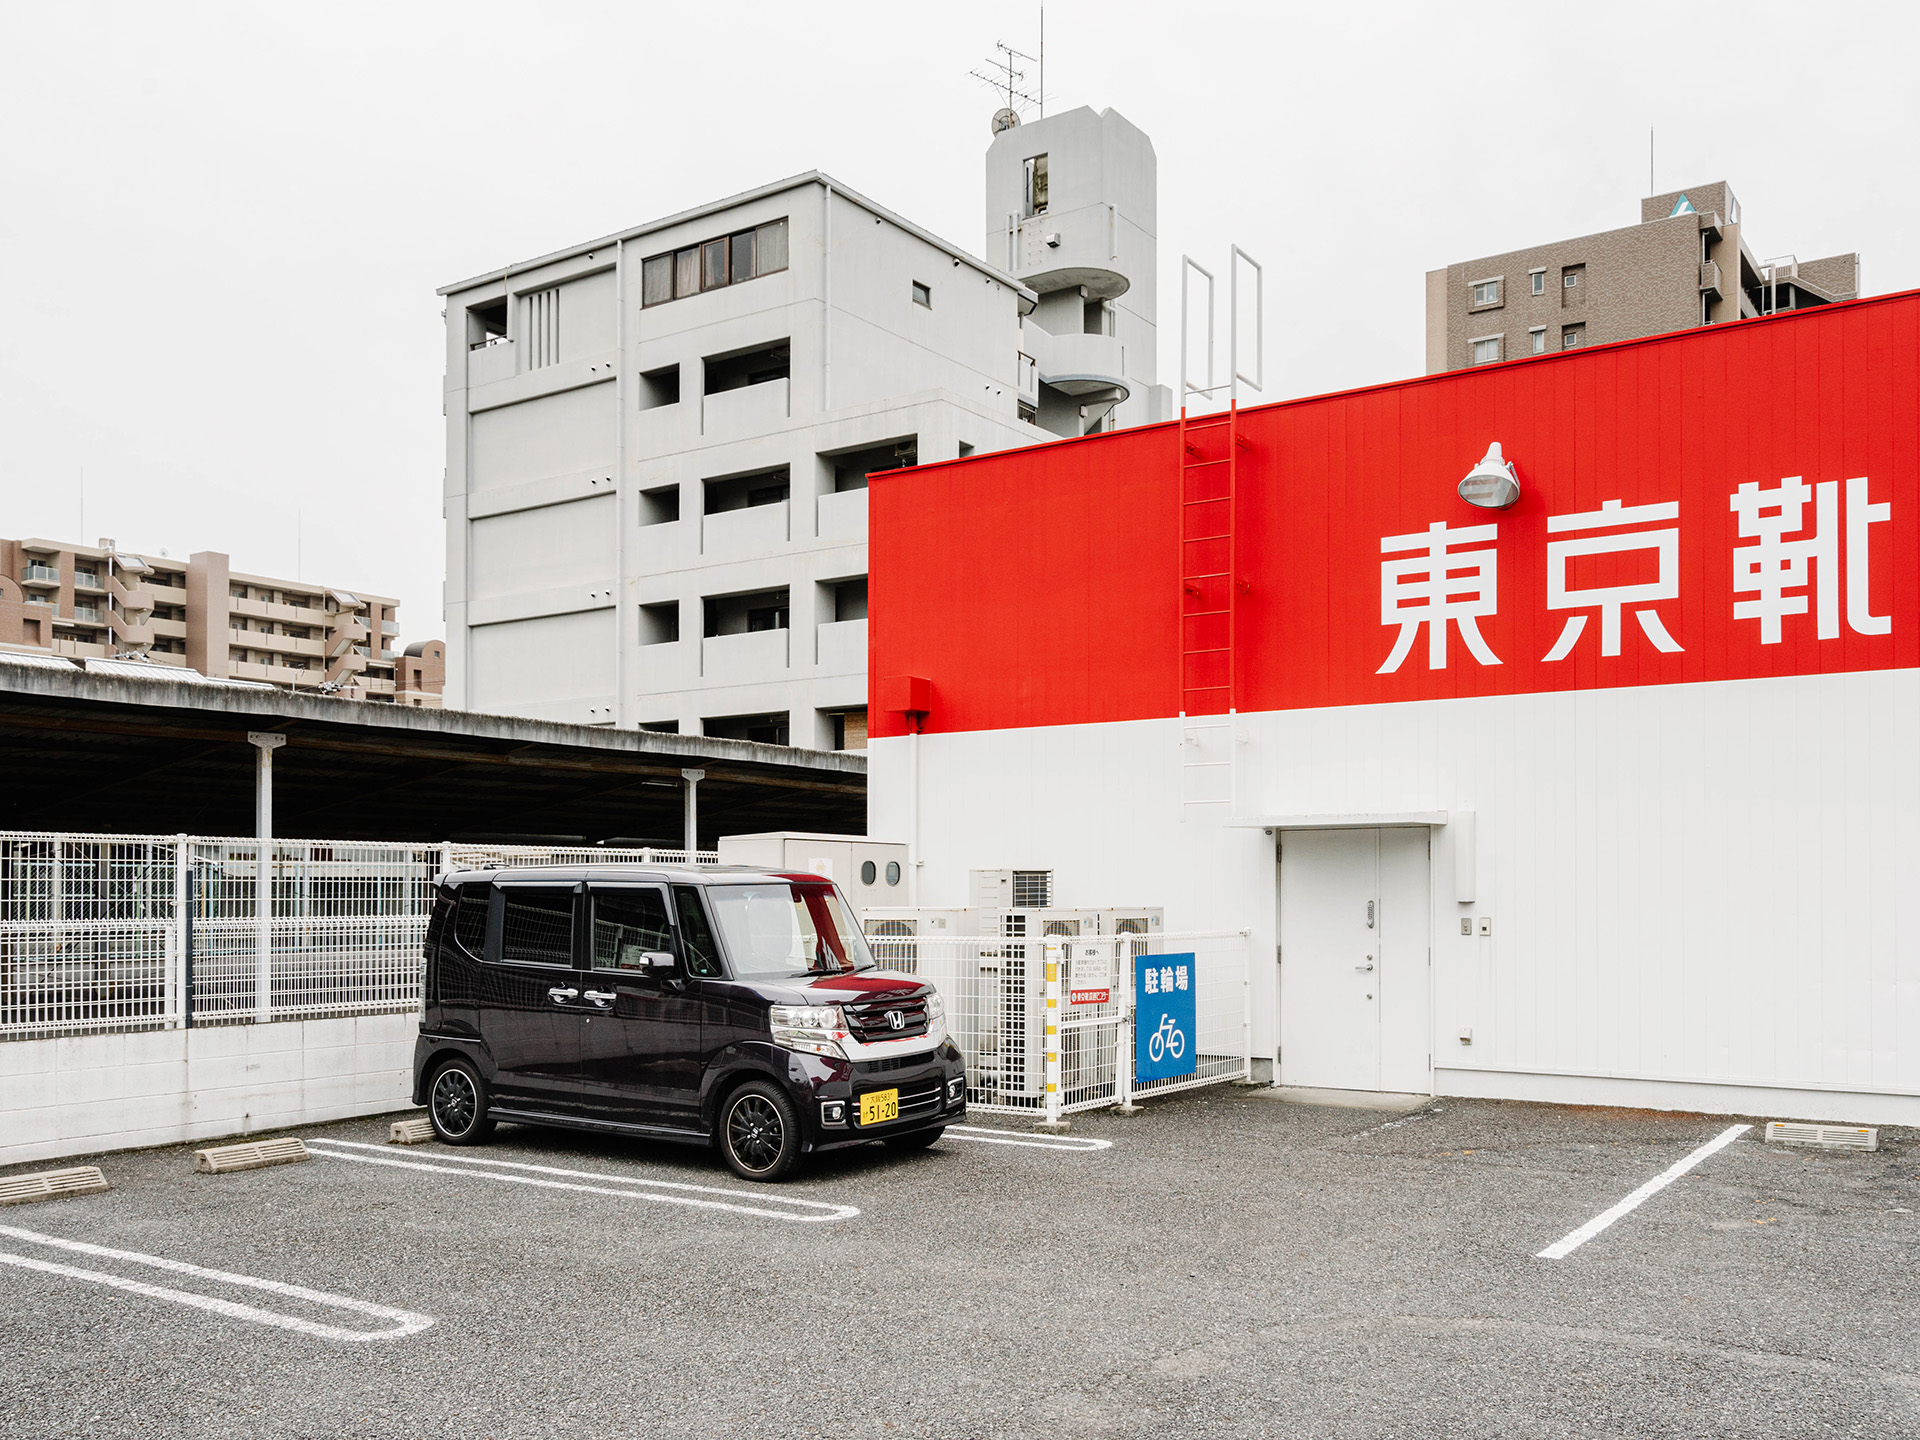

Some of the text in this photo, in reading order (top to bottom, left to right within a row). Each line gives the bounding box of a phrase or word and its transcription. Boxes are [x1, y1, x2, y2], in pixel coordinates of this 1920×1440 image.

[1375, 476, 1892, 675] 東京靴
[1145, 965, 1189, 994] 駐輪場
[869, 1101, 897, 1121] 51-20
